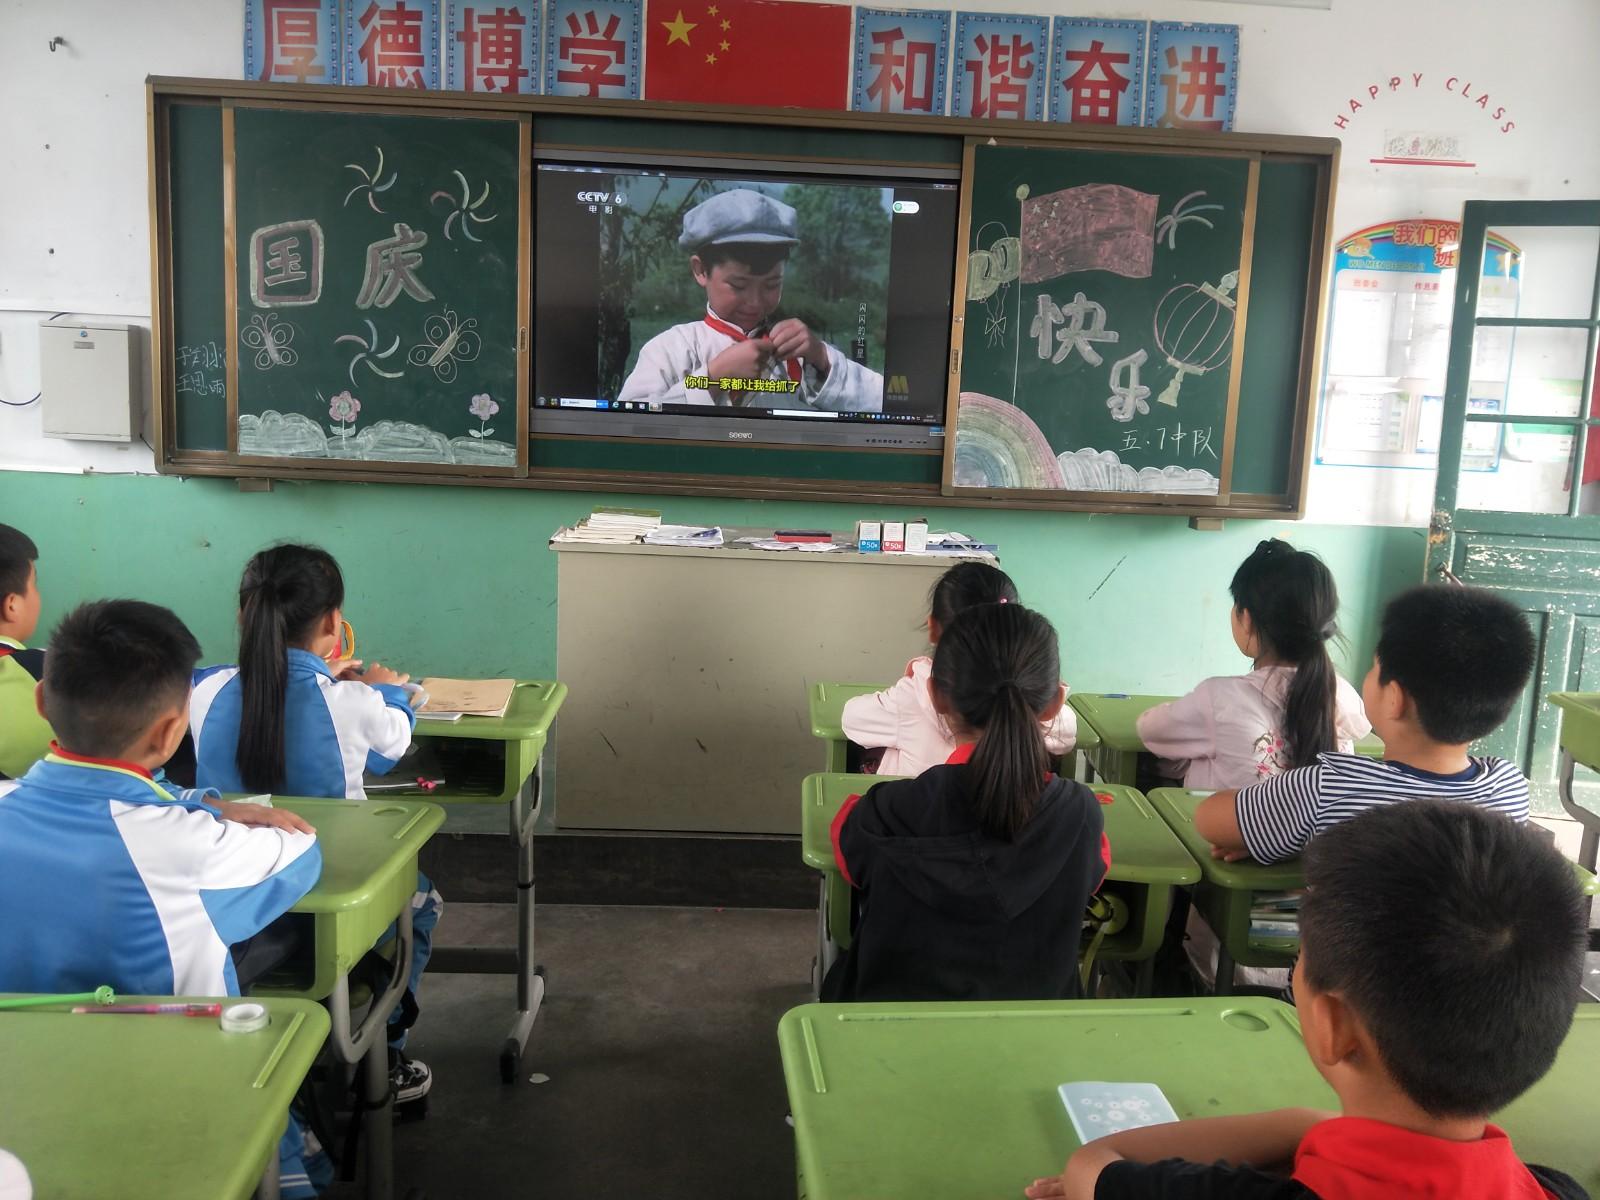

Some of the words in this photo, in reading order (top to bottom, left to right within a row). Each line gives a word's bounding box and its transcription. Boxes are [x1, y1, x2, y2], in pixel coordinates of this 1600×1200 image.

[259, 0, 627, 98] 厚德博学
[865, 27, 1227, 132] 和谐奋进
[1333, 73, 1423, 129] HAPPY
[1445, 77, 1515, 133] CLASS
[577, 191, 610, 203] CCTV
[250, 219, 436, 309] 国庆
[684, 376, 801, 393] 你们一家都让我给抓了
[1030, 291, 1152, 423] 快乐
